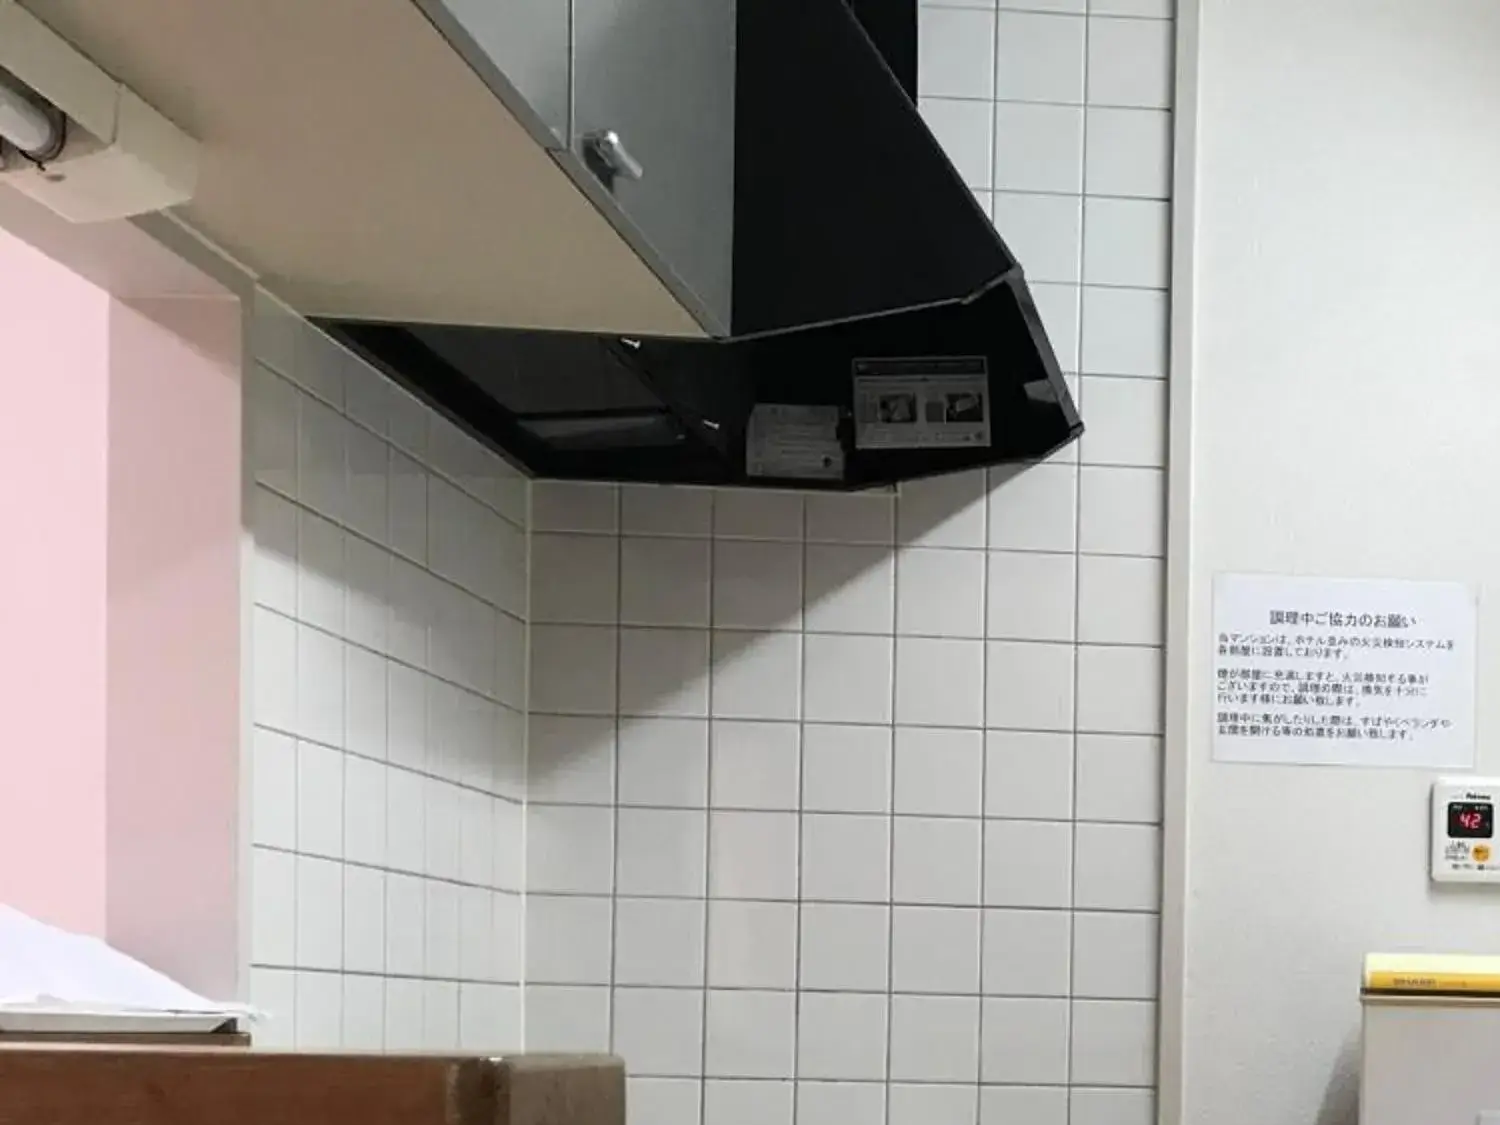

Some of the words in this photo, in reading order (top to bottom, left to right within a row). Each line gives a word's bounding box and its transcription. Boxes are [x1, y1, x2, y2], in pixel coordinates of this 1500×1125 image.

[1269, 609, 1417, 629] 調理中ご協力のお願い
[1459, 811, 1483, 829] 42
